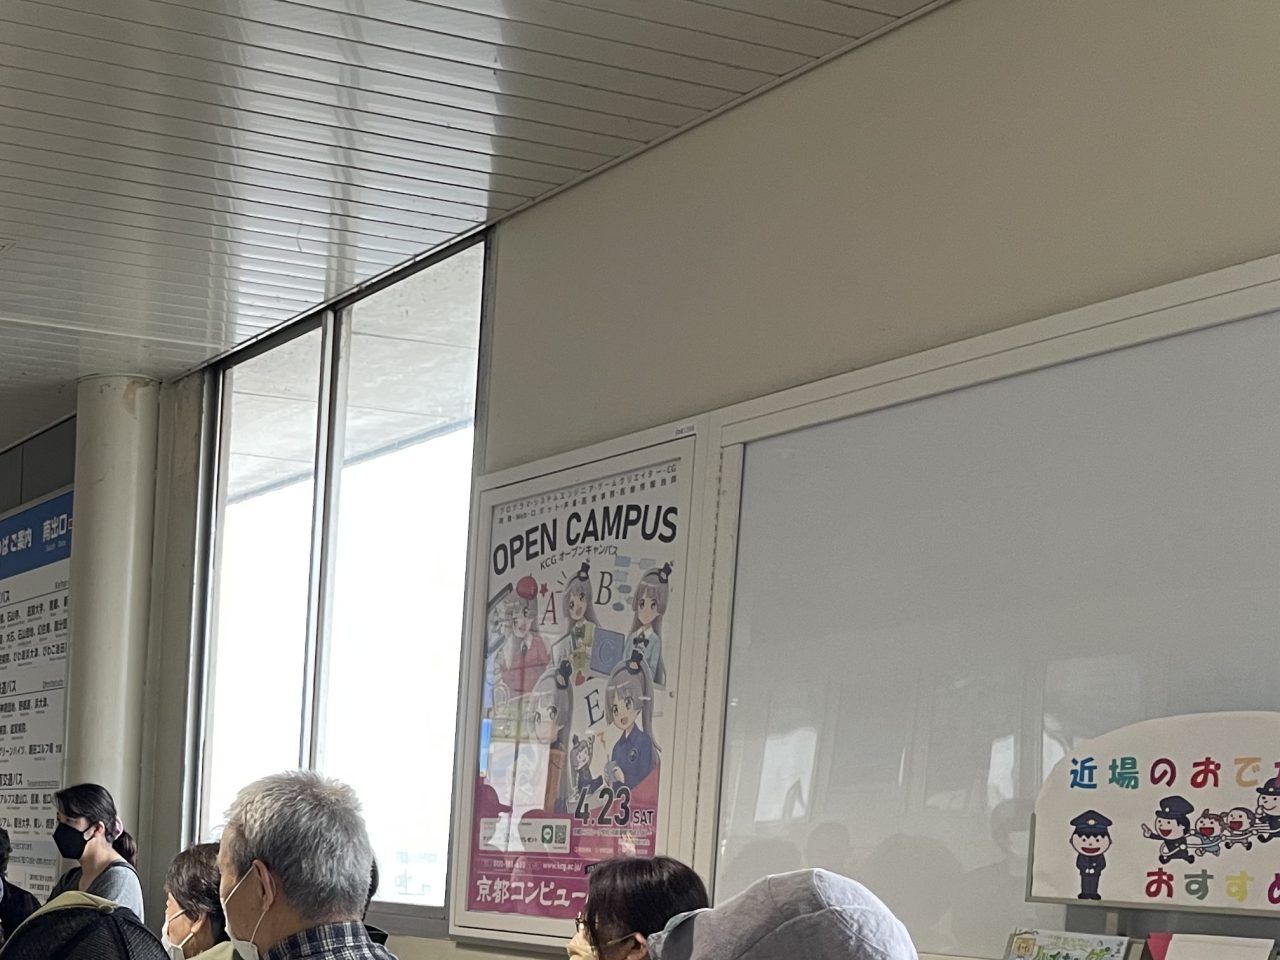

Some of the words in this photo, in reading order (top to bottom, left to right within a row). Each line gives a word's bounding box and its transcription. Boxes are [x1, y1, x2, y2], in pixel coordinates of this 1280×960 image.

[493, 518, 557, 576] OPEN
[566, 504, 678, 546] CAMPUS
[540, 555, 557, 570] KCG
[559, 546, 618, 561] オープンキャンパス
[540, 592, 558, 625] A
[595, 571, 613, 605] B
[584, 689, 605, 727] E
[1070, 756, 1280, 790] 近場のおで
[574, 786, 632, 826] 4.23
[633, 810, 654, 824] SAT
[476, 875, 590, 907] 京都コンピュー
